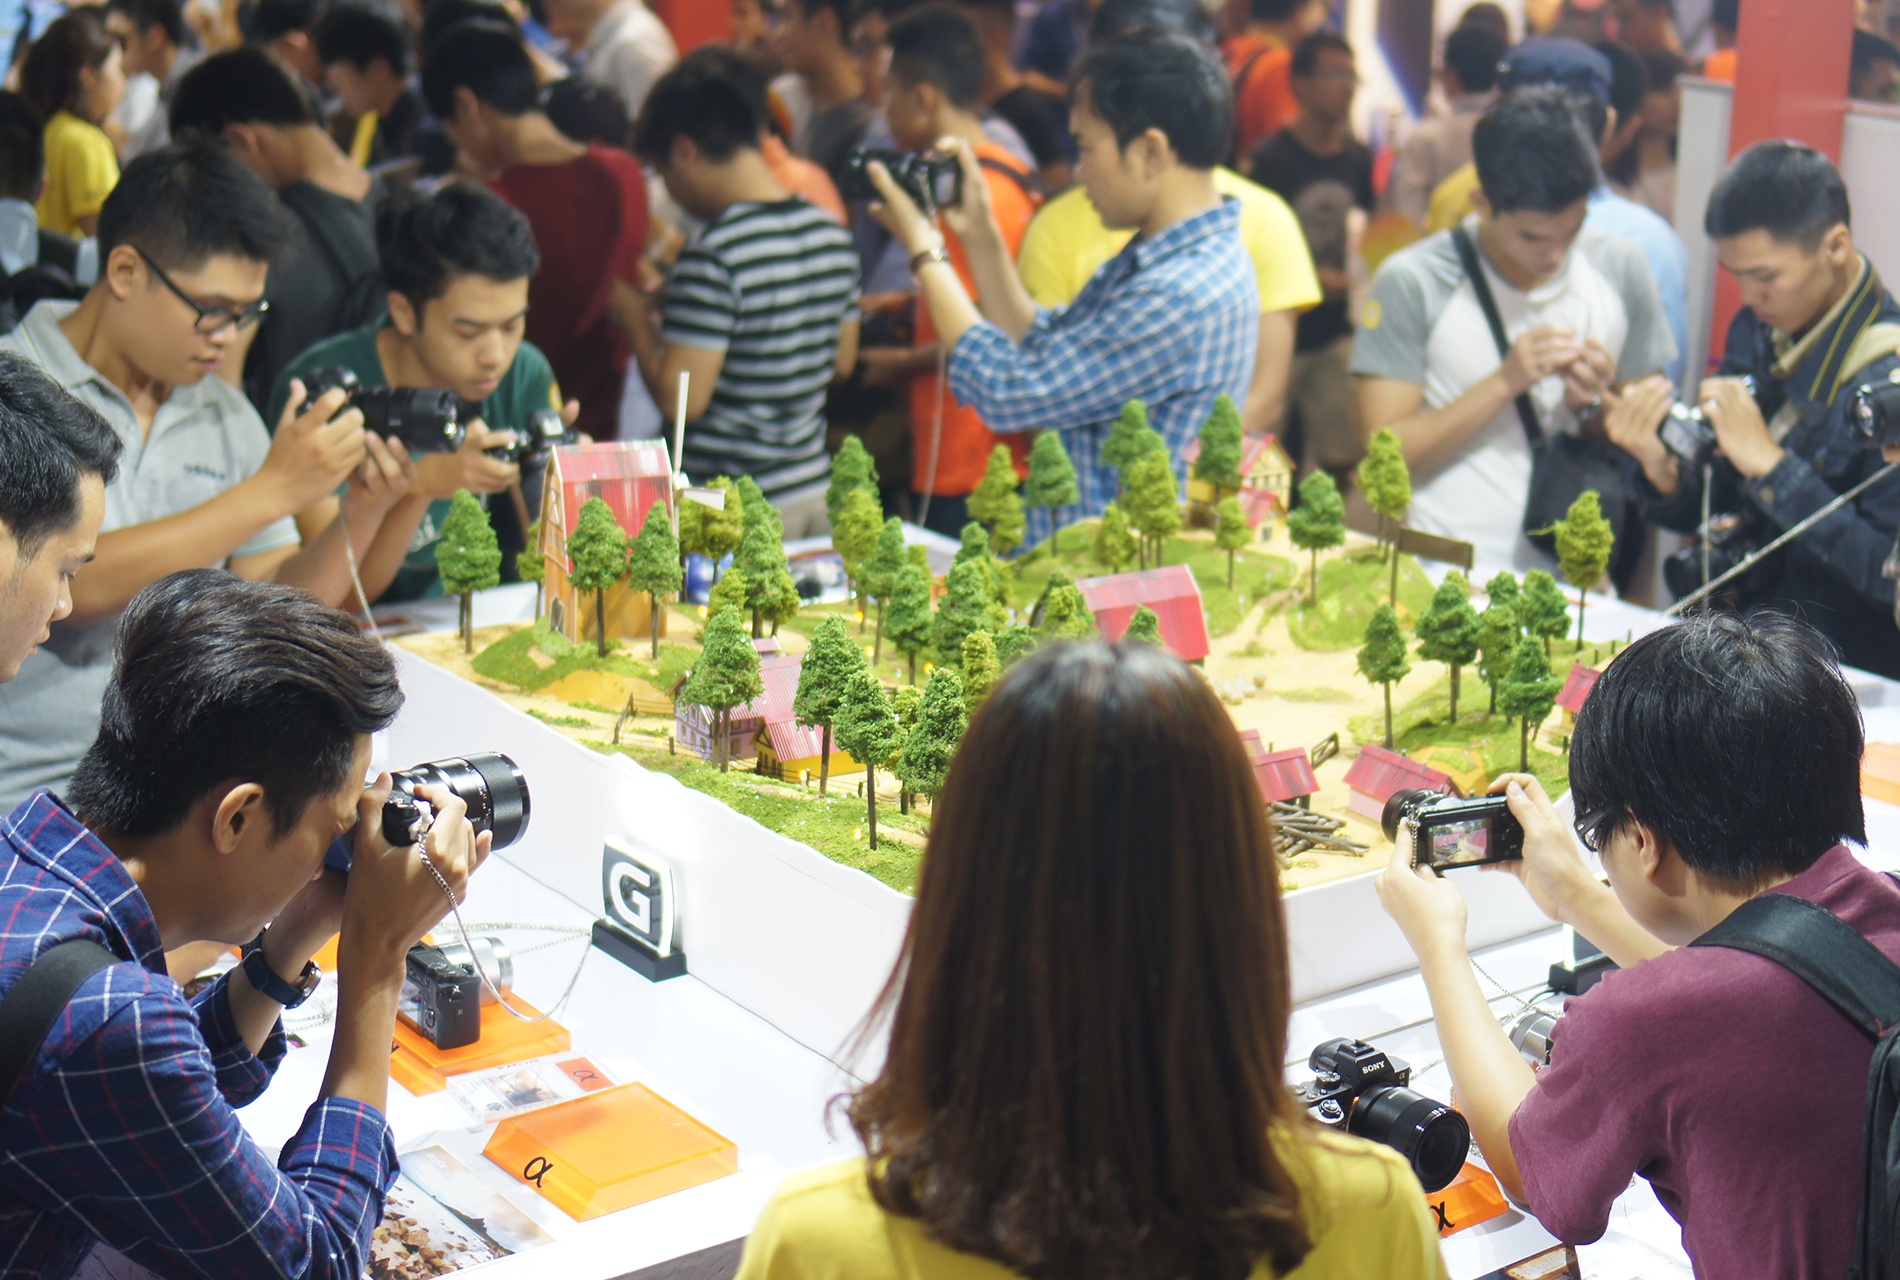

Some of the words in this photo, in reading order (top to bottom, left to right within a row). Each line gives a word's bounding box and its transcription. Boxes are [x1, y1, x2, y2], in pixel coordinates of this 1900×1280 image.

[610, 861, 651, 935] G
[1362, 1060, 1385, 1074] SONY
[523, 1156, 554, 1188] α
